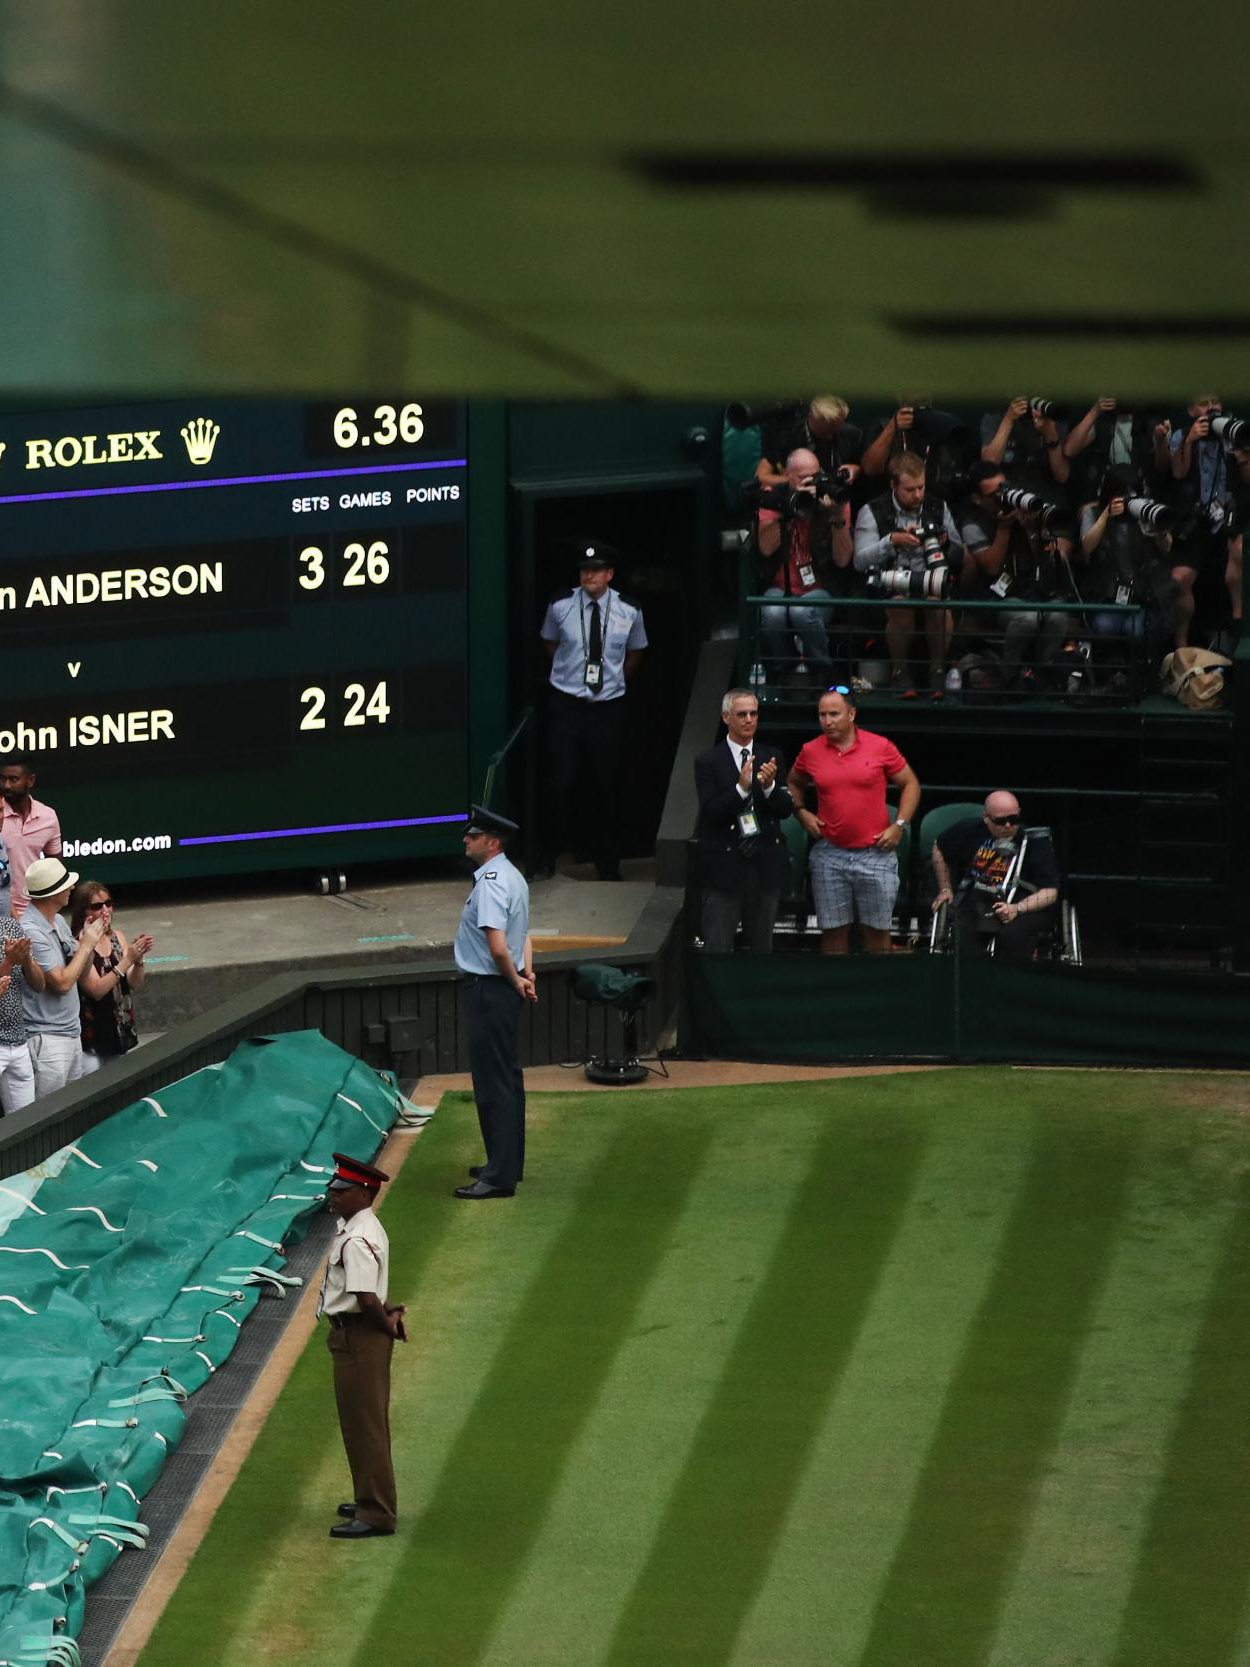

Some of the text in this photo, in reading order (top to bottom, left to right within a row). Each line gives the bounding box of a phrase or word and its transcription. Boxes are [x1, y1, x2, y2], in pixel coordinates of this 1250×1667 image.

[333, 402, 424, 449] 6.36
[25, 430, 164, 470] ROLEX
[291, 496, 330, 513] SETS
[338, 491, 392, 509] GAMES
[406, 485, 460, 503] POINTS
[24, 561, 223, 609] ANDERSON
[298, 541, 390, 590] 3 26
[299, 681, 391, 731] 2 24
[69, 710, 176, 748] ISNER
[61, 834, 172, 858] bledon.com
